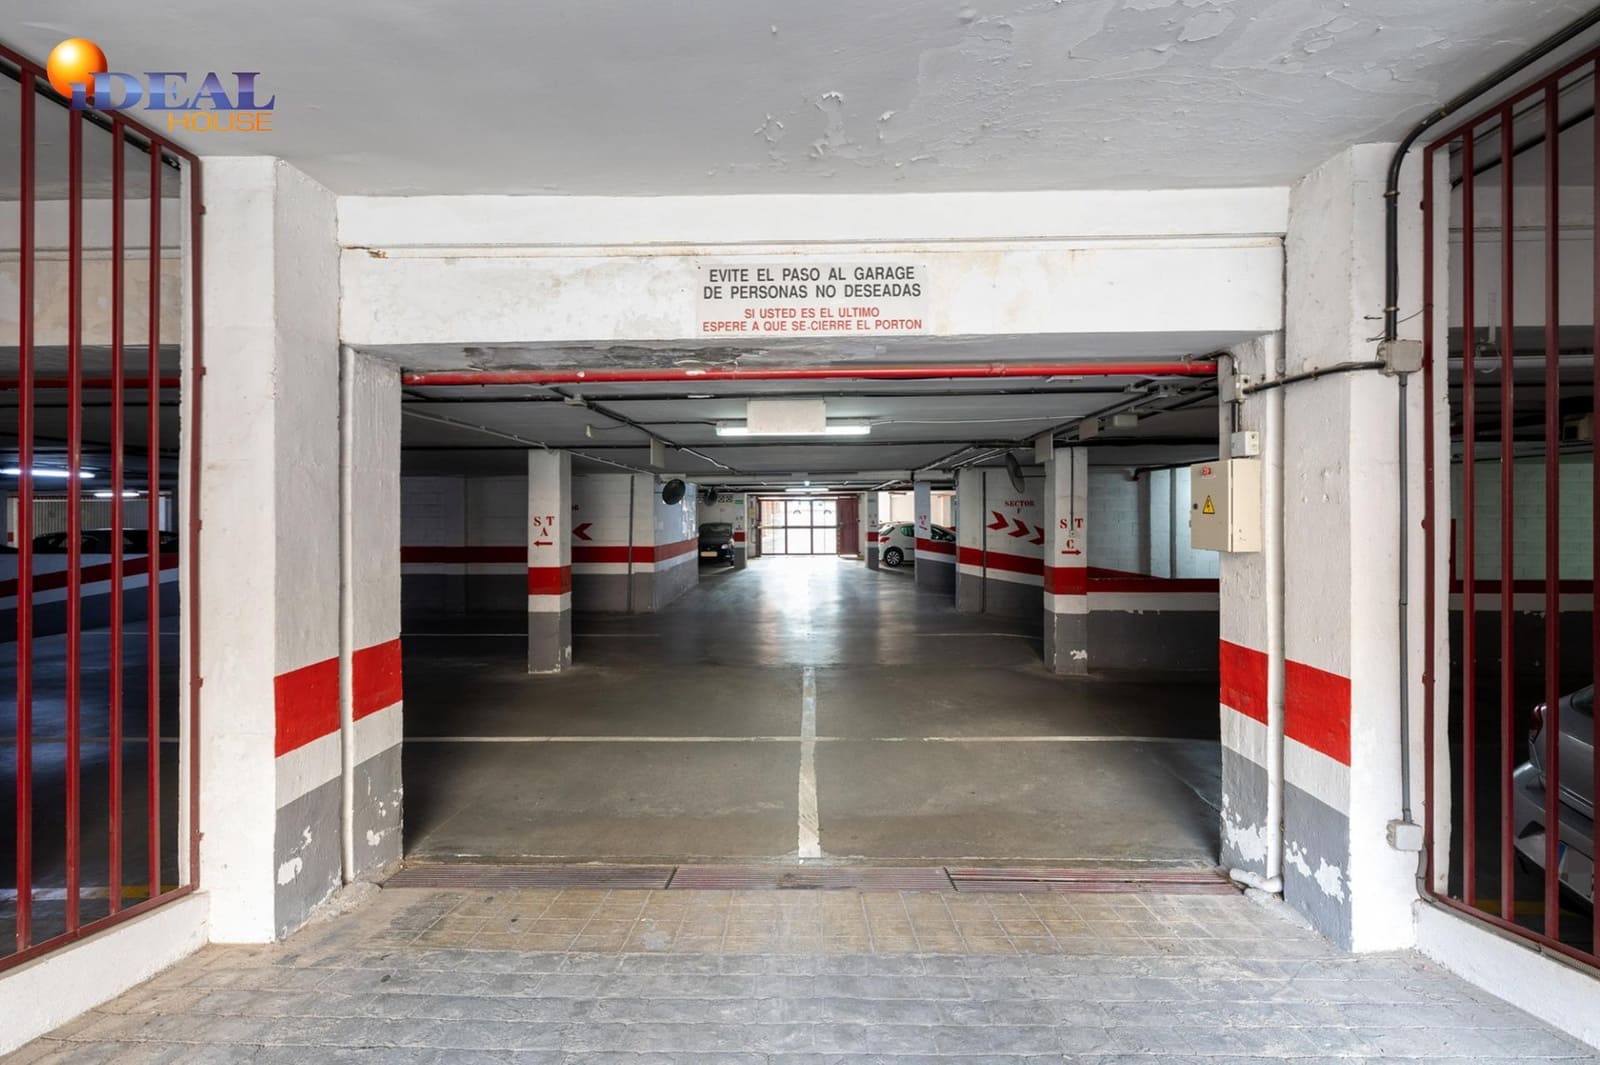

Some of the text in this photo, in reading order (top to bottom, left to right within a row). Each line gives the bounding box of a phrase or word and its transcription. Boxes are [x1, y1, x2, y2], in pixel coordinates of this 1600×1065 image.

[709, 266, 915, 282] EVITE EL PASO AL GARAGE
[704, 283, 921, 299] DE PERSONAS NO DESEADAS
[744, 307, 880, 319] SI USTED ES EL ULTIMO
[703, 319, 922, 332] ESPERE A QUE SE CIERRE EL PORTON
[540, 527, 548, 536] A
